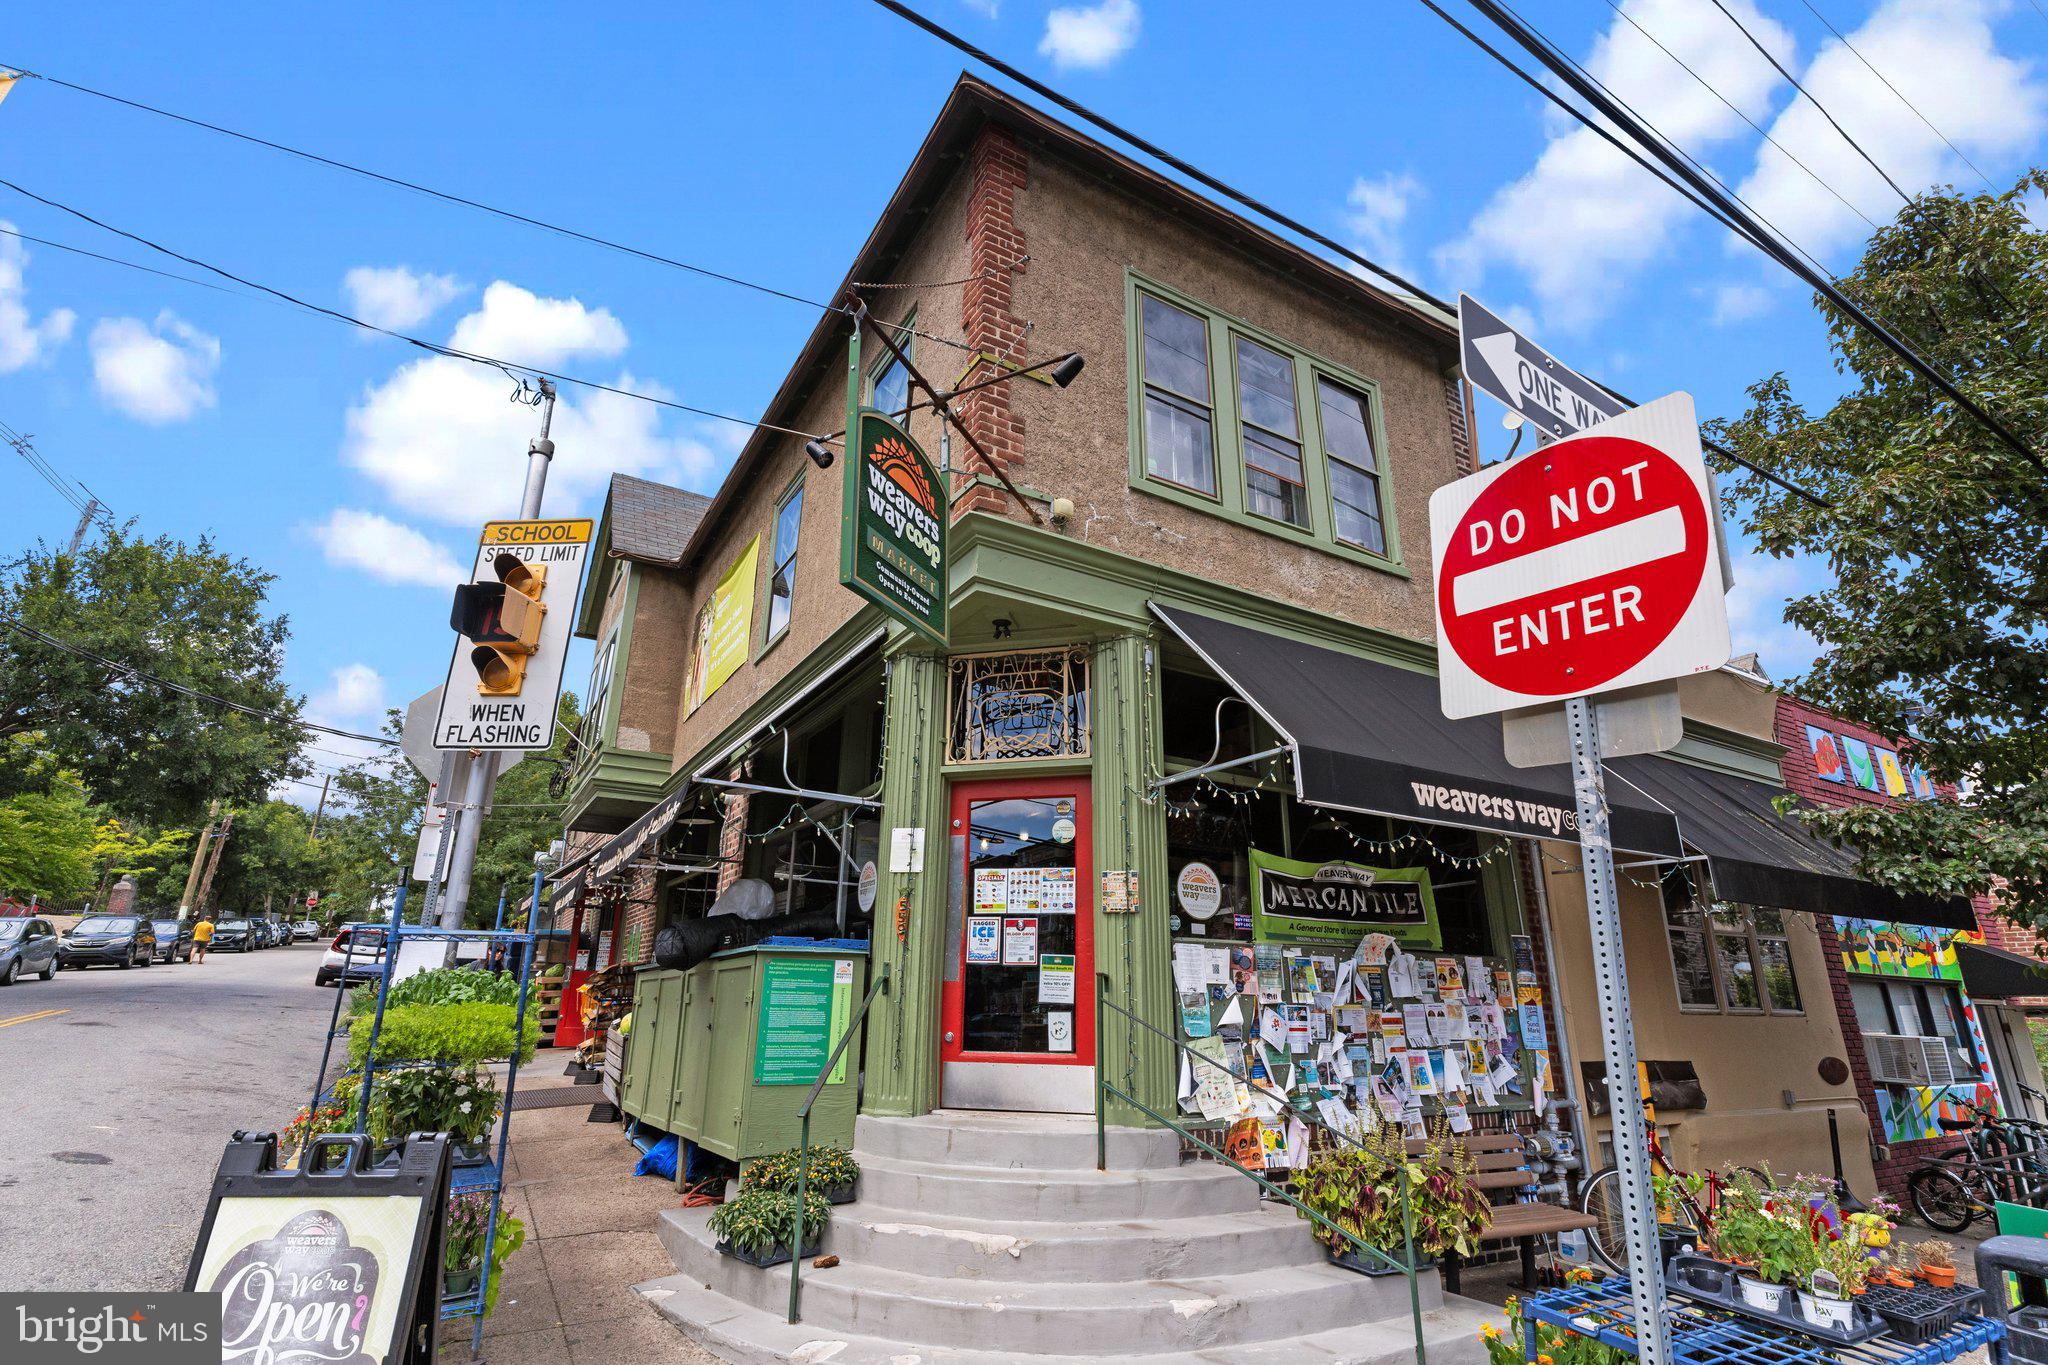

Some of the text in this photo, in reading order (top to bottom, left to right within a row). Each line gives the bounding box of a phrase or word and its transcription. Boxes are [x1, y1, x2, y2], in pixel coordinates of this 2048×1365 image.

[1518, 360, 1605, 428] ONE WA
[868, 462, 939, 542] weavers
[1470, 461, 1649, 556] DO NOT
[497, 525, 577, 541] SCHOOL
[867, 486, 941, 569] way coop
[540, 545, 580, 561] LIMIT
[872, 535, 935, 593] MARKET
[1493, 585, 1646, 657] ENTER
[471, 704, 525, 722] WHEN
[446, 725, 541, 743] FLASHING
[1411, 782, 1581, 836] weavers way co
[1182, 883, 1217, 893] weavers
[1182, 891, 1199, 901] way
[1267, 879, 1419, 917] MERCANTILE
[972, 927, 995, 938] ICE
[1296, 924, 1323, 933] General
[1324, 925, 1340, 934] Store
[287, 1236, 337, 1246] weavers
[285, 1245, 309, 1257] way
[289, 1269, 349, 1298] We're
